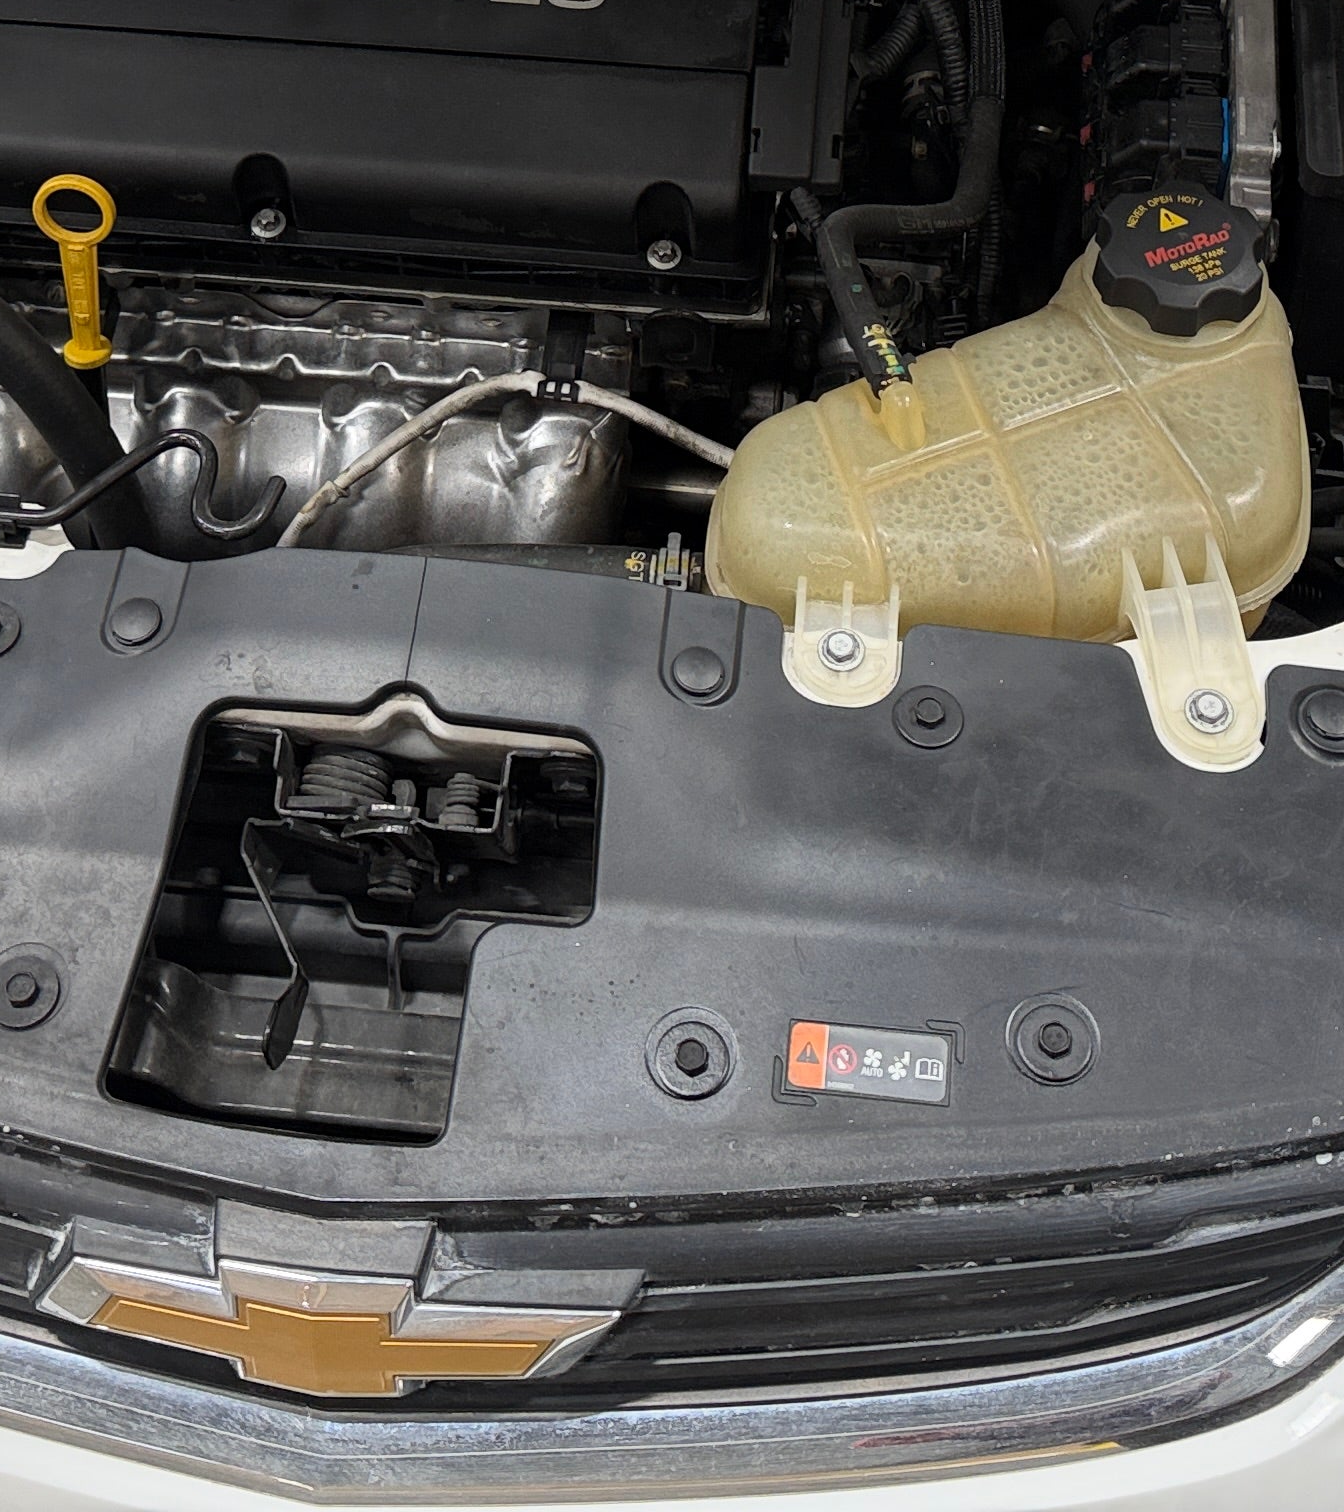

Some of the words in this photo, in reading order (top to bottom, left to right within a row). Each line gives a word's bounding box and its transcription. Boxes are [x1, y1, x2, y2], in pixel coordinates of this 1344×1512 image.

[1126, 204, 1148, 228] NEVER
[1147, 195, 1173, 207] OPEN
[1170, 255, 1202, 271] SURGE
[1202, 247, 1227, 260] TANK
[1207, 267, 1224, 277] PSI
[860, 1066, 883, 1078] AUTO
